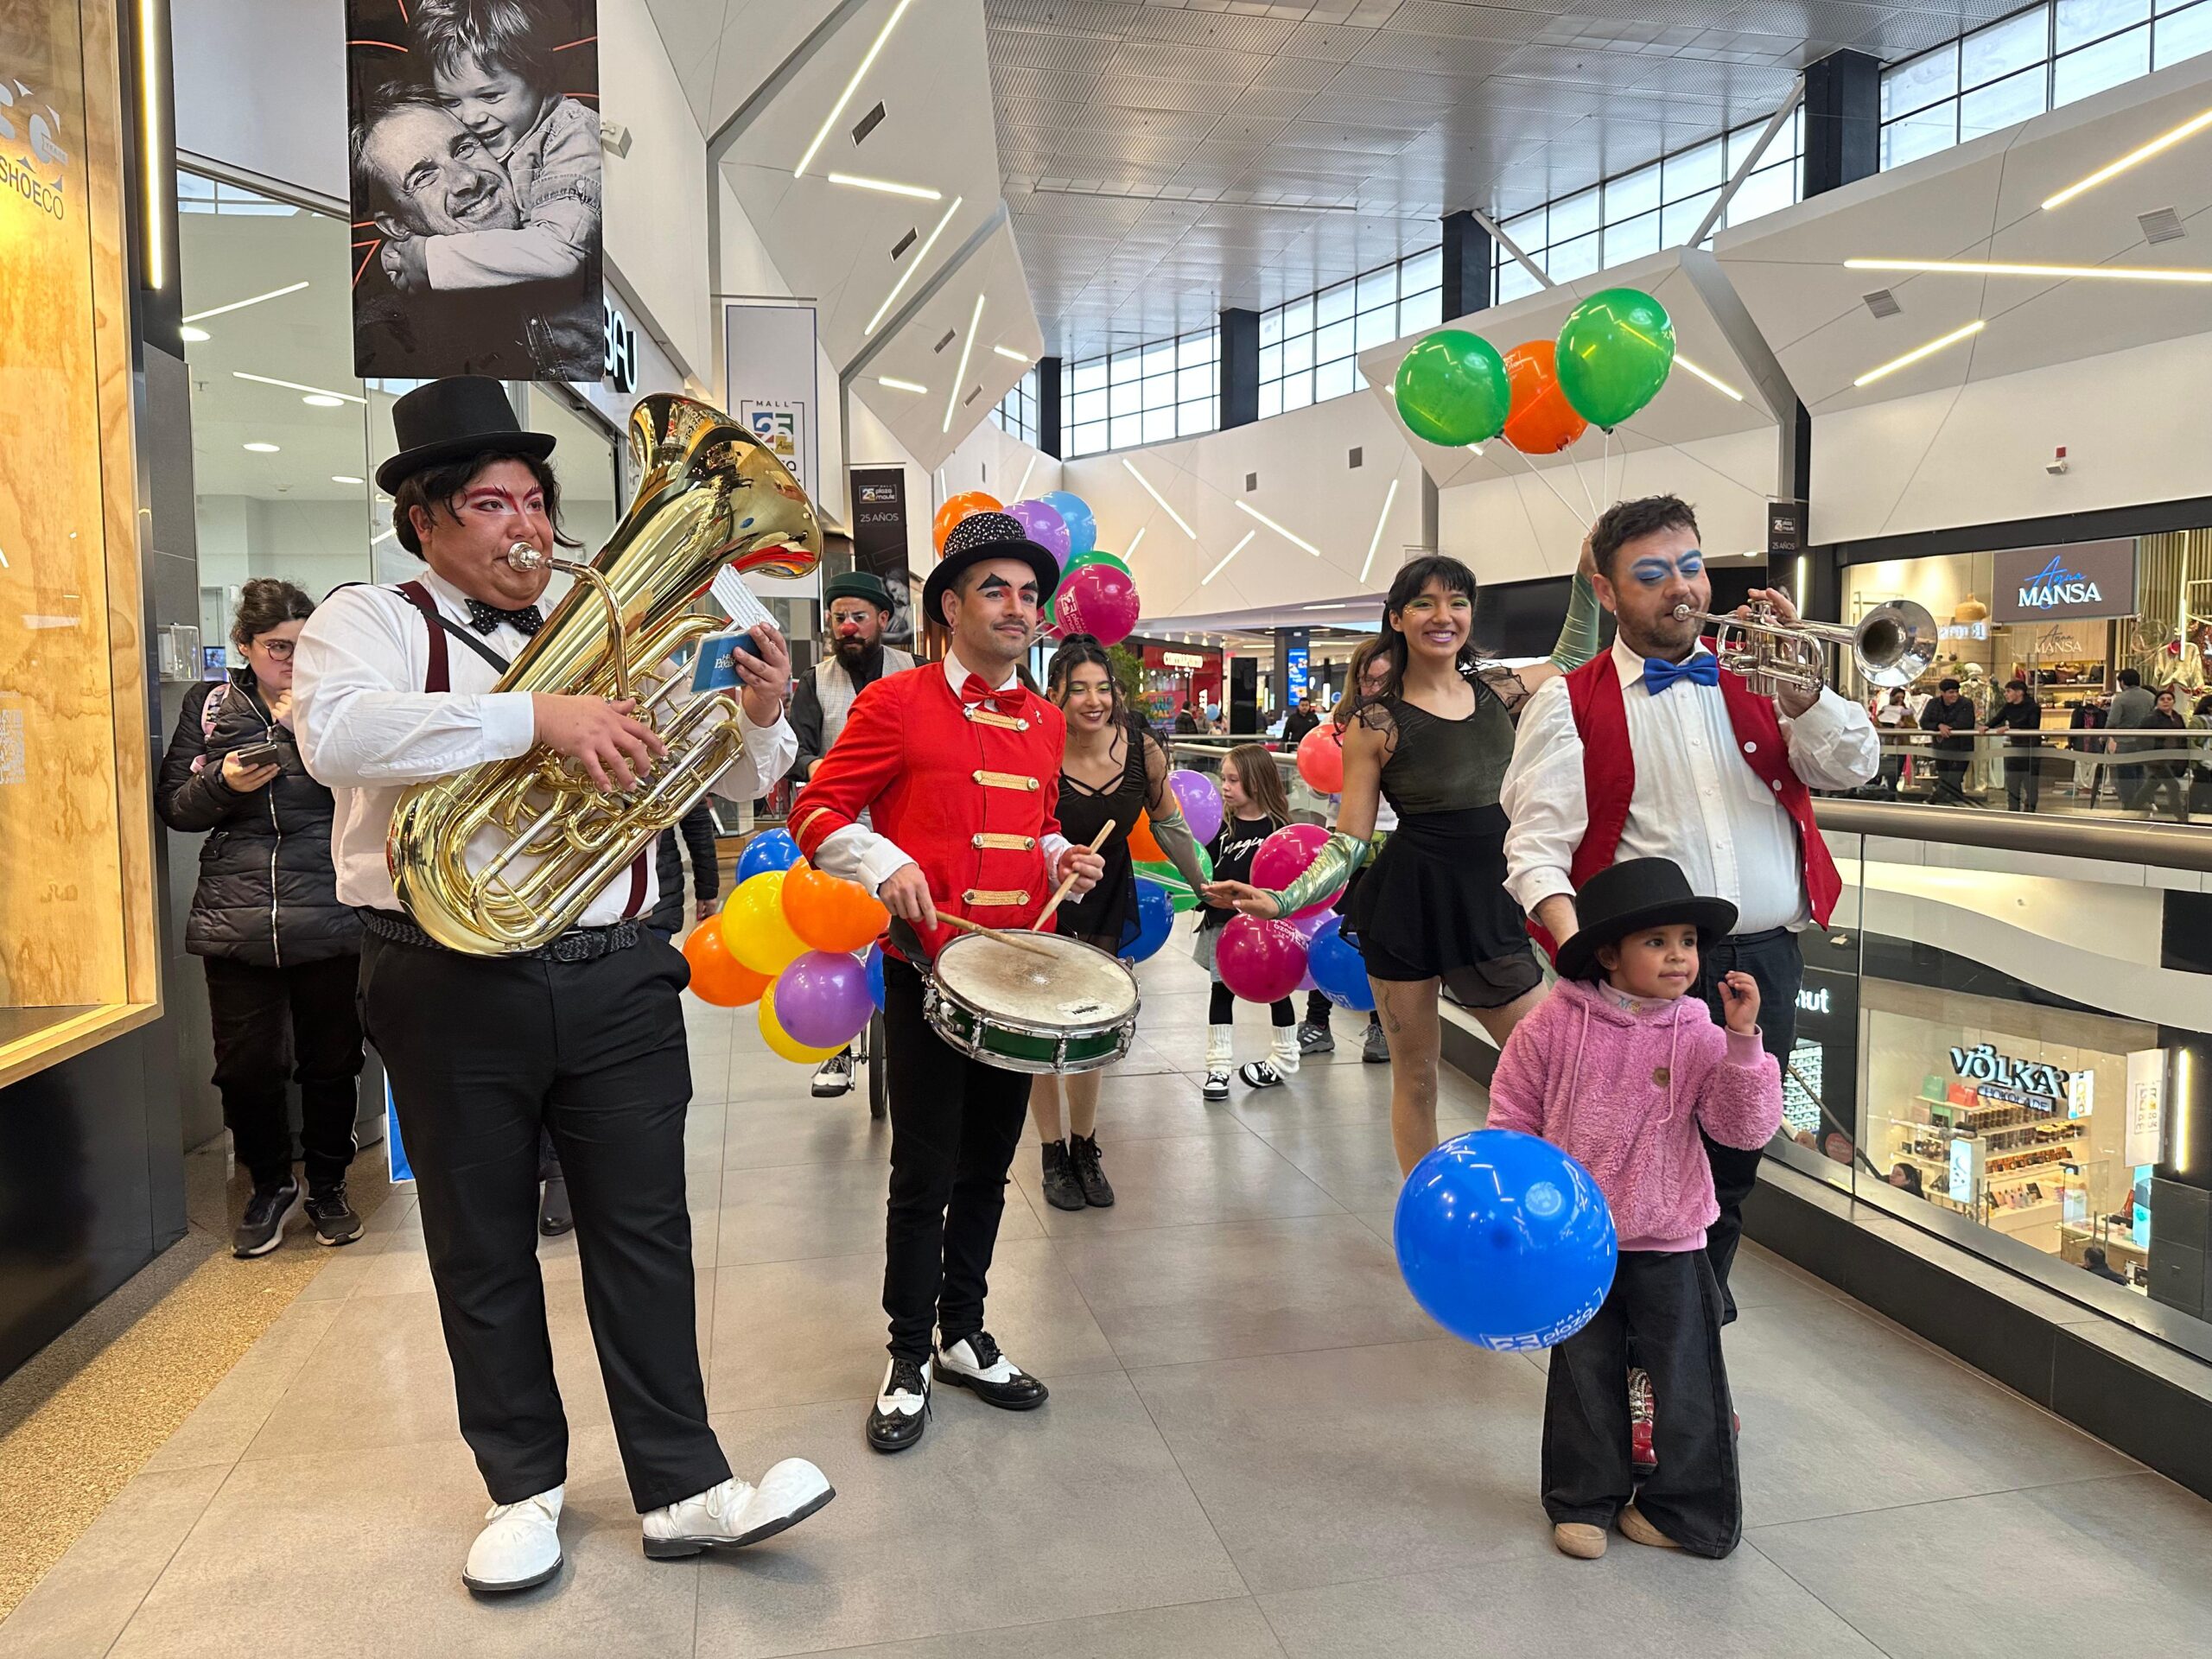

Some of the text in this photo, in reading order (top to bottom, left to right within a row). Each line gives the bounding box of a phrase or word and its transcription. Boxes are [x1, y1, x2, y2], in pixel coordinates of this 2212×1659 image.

[860, 512, 899, 523] 25 AÑOS
[2018, 582, 2102, 607] MANSA
[2034, 640, 2082, 654] MANSA
[1950, 1043, 2064, 1098] VÖLKA
